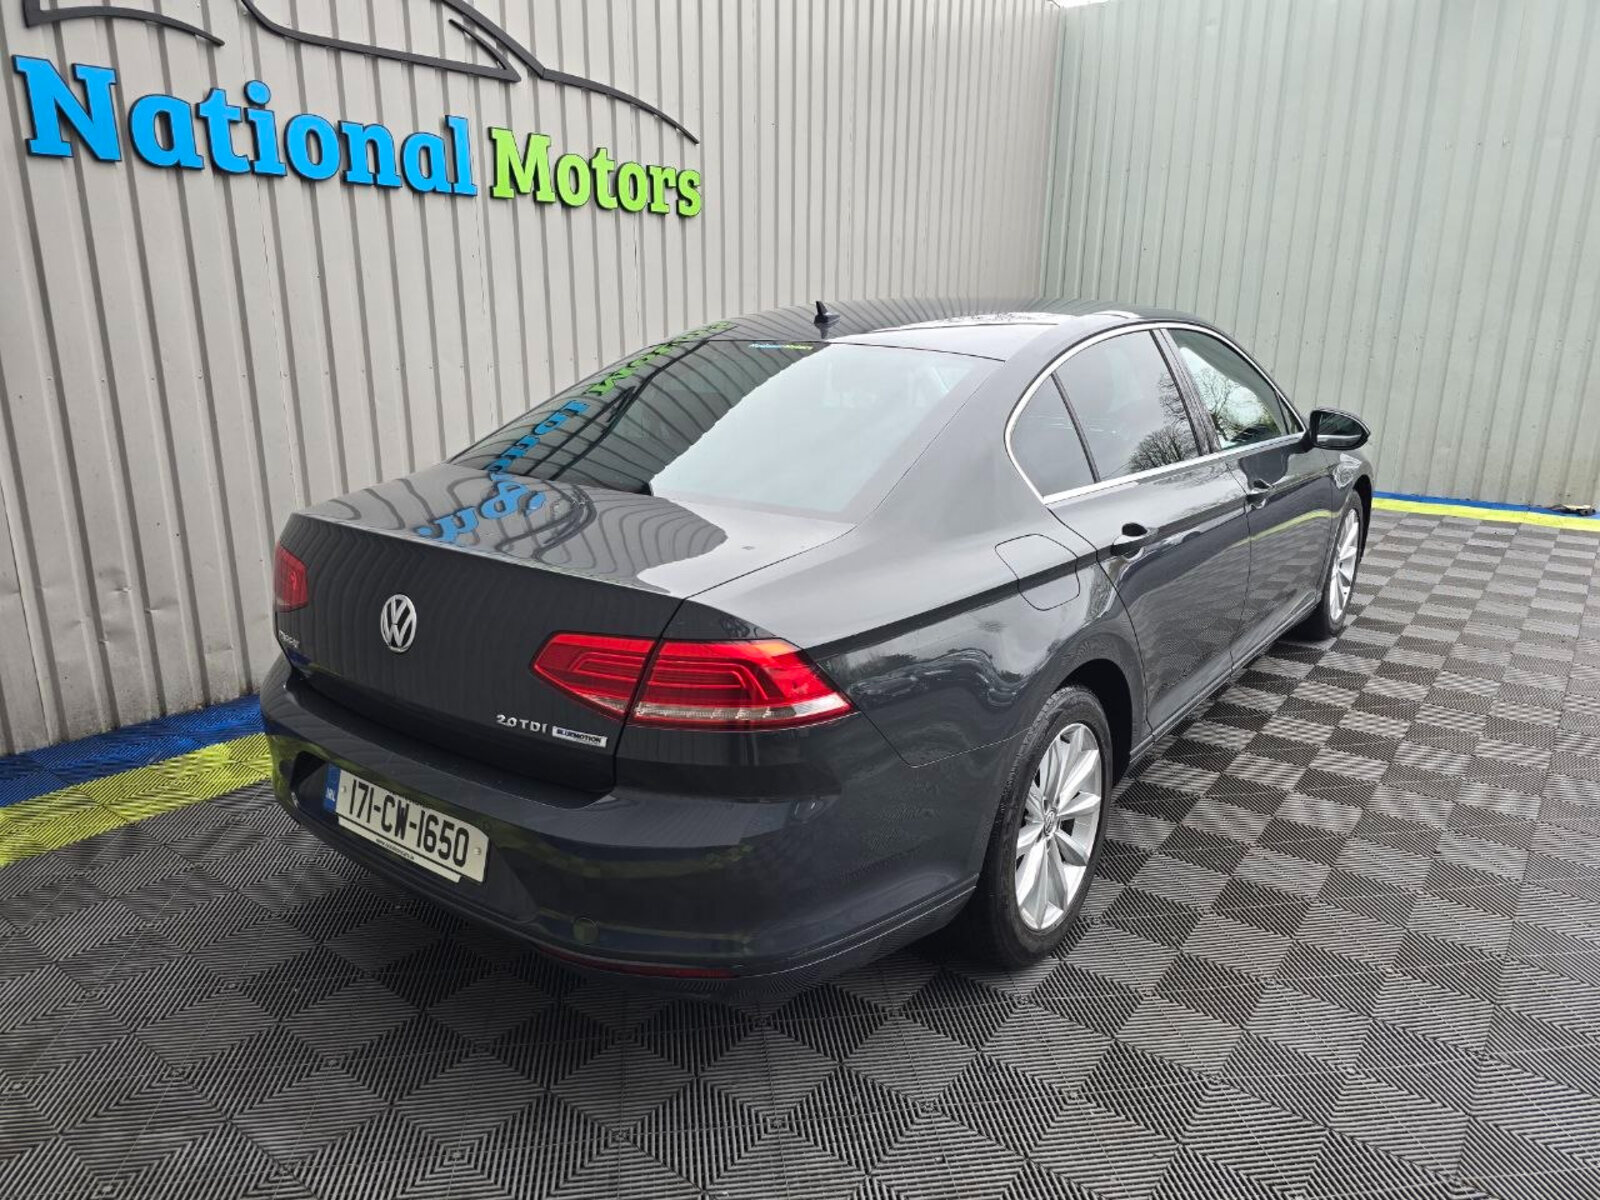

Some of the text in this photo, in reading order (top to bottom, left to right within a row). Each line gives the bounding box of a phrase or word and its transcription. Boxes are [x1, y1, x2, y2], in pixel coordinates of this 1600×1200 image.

[13, 55, 702, 217] National Motors
[349, 779, 470, 868] 171-CW-1650
